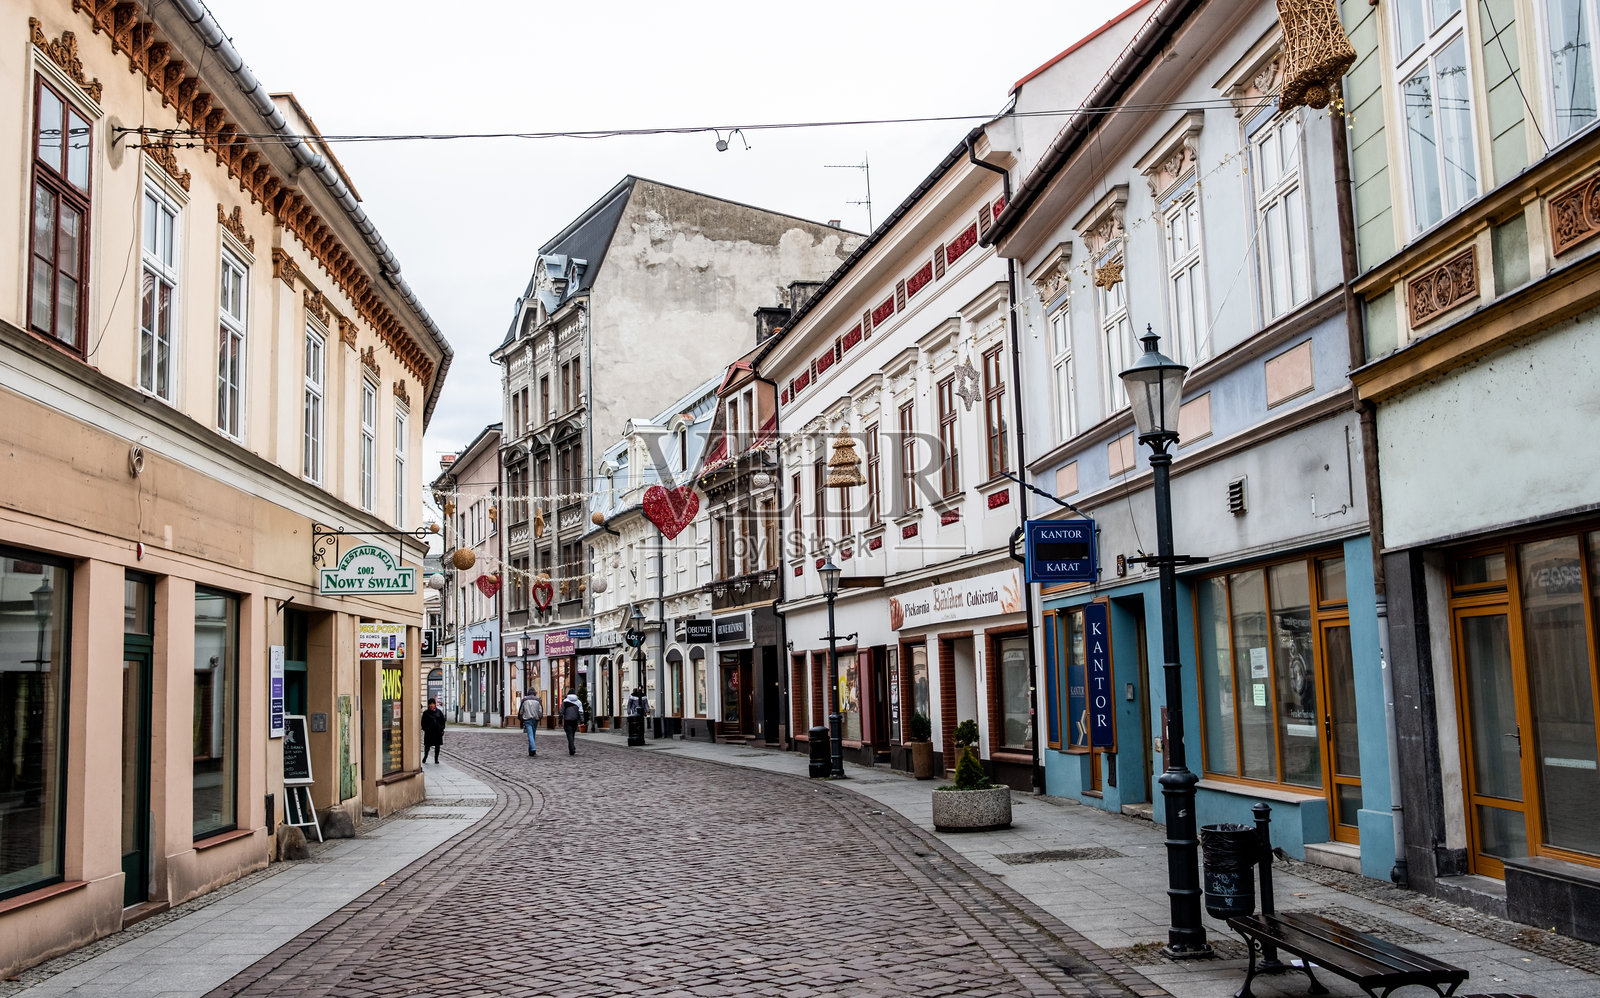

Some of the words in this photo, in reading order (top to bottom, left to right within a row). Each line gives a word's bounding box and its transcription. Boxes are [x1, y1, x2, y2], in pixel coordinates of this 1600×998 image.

[1040, 530, 1082, 539] KANTOR
[340, 547, 393, 571] RESTAURACJA
[1046, 563, 1080, 572] KARAT
[325, 574, 364, 588] NOWY
[368, 573, 410, 588] ŚWIAT
[904, 600, 930, 618] Piekarnia
[966, 587, 999, 607] Cukiernia
[687, 626, 712, 634] OBUWIE
[1091, 622, 1107, 727] KANTOR
